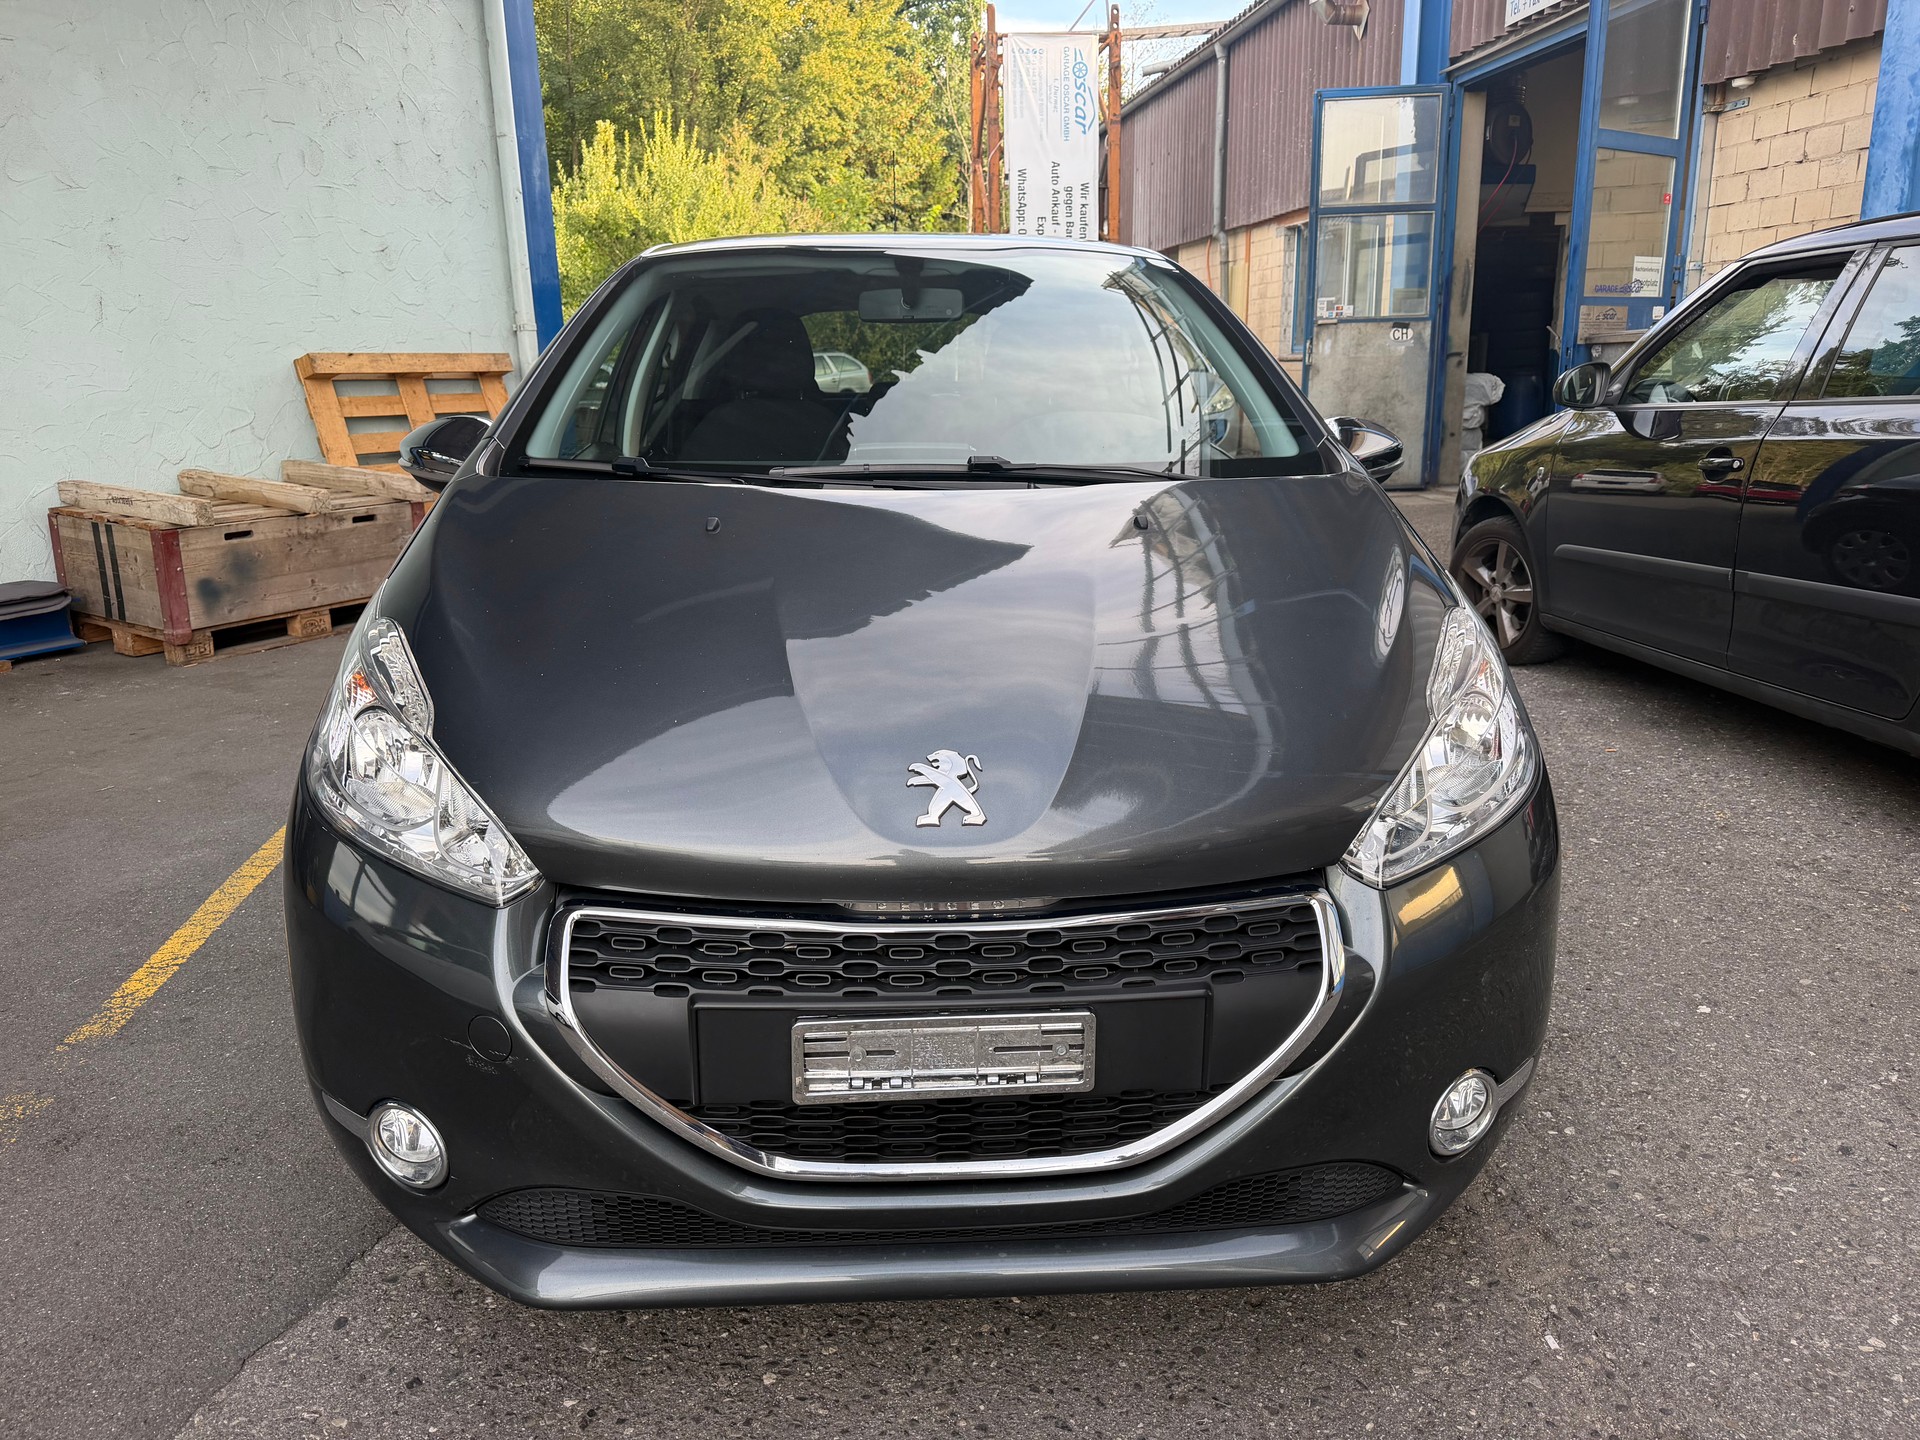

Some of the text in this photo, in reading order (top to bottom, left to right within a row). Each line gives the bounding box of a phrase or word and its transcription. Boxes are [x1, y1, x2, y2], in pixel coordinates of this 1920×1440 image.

[1062, 116, 1070, 142] GMBH
[1050, 161, 1061, 186] Auto
[1016, 168, 1027, 226] WhatsApp:
[1051, 188, 1061, 226] Ankauf
[1063, 186, 1073, 218] gegen
[1079, 182, 1090, 239] Wir kaufen
[1594, 284, 1618, 293] GARAGE
[1392, 328, 1409, 341] CH
